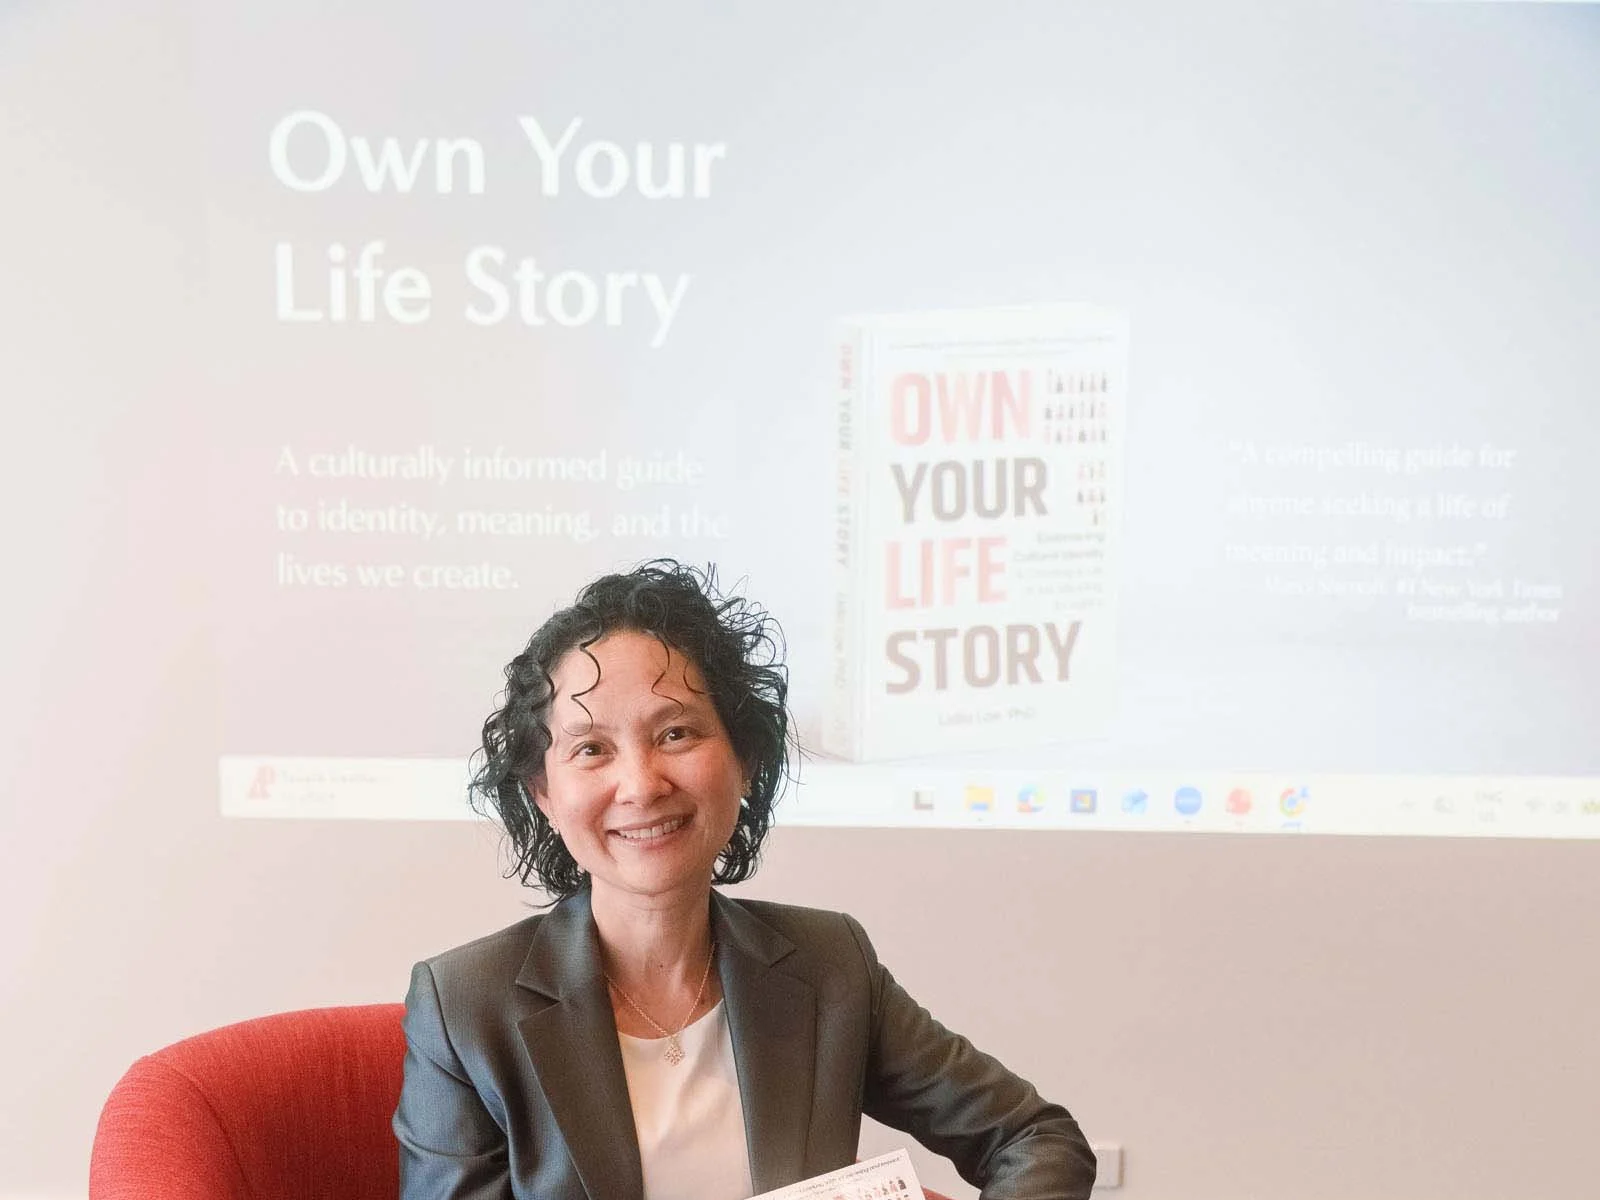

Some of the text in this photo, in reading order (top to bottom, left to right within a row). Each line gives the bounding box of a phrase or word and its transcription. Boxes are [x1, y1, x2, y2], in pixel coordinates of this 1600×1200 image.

[269, 109, 728, 199] Own Your
[275, 240, 694, 347] Life Story
[890, 369, 1033, 447] OWN
[275, 444, 705, 490] A culturally informed guide
[889, 456, 1049, 525] YOUR
[276, 499, 730, 543] to identity, meaning, and the
[275, 552, 520, 590] lives we create.
[884, 535, 1008, 611] LIFE
[884, 619, 1084, 696] STORY
